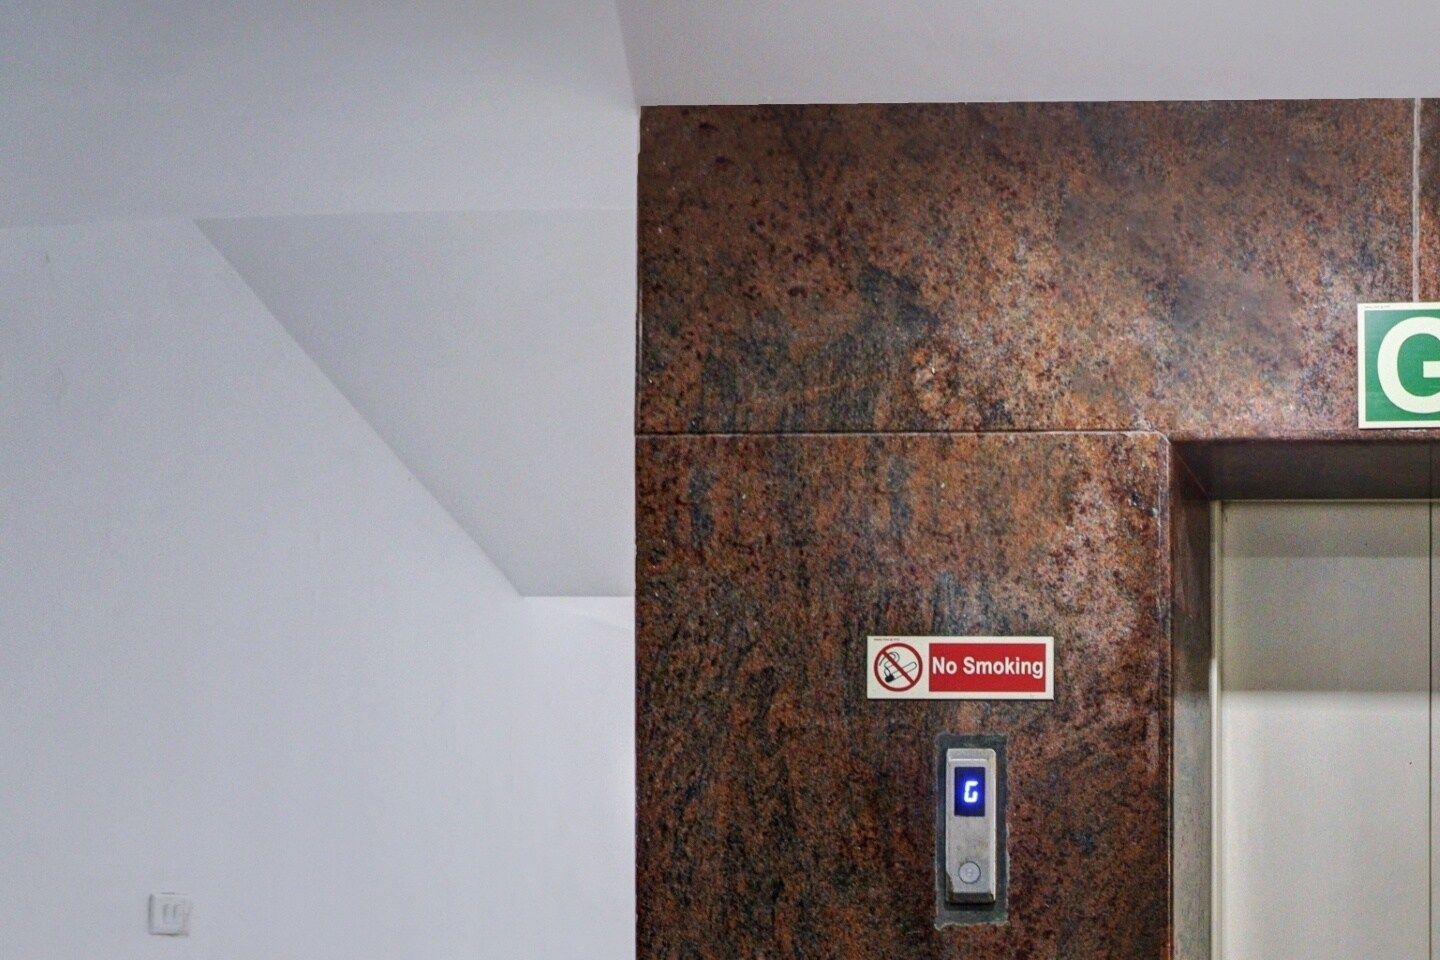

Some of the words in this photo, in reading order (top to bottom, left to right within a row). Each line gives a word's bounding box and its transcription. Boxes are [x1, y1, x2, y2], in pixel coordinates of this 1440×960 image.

[932, 656, 958, 675] No
[963, 656, 1044, 679] Smoking
[964, 781, 978, 803] G
